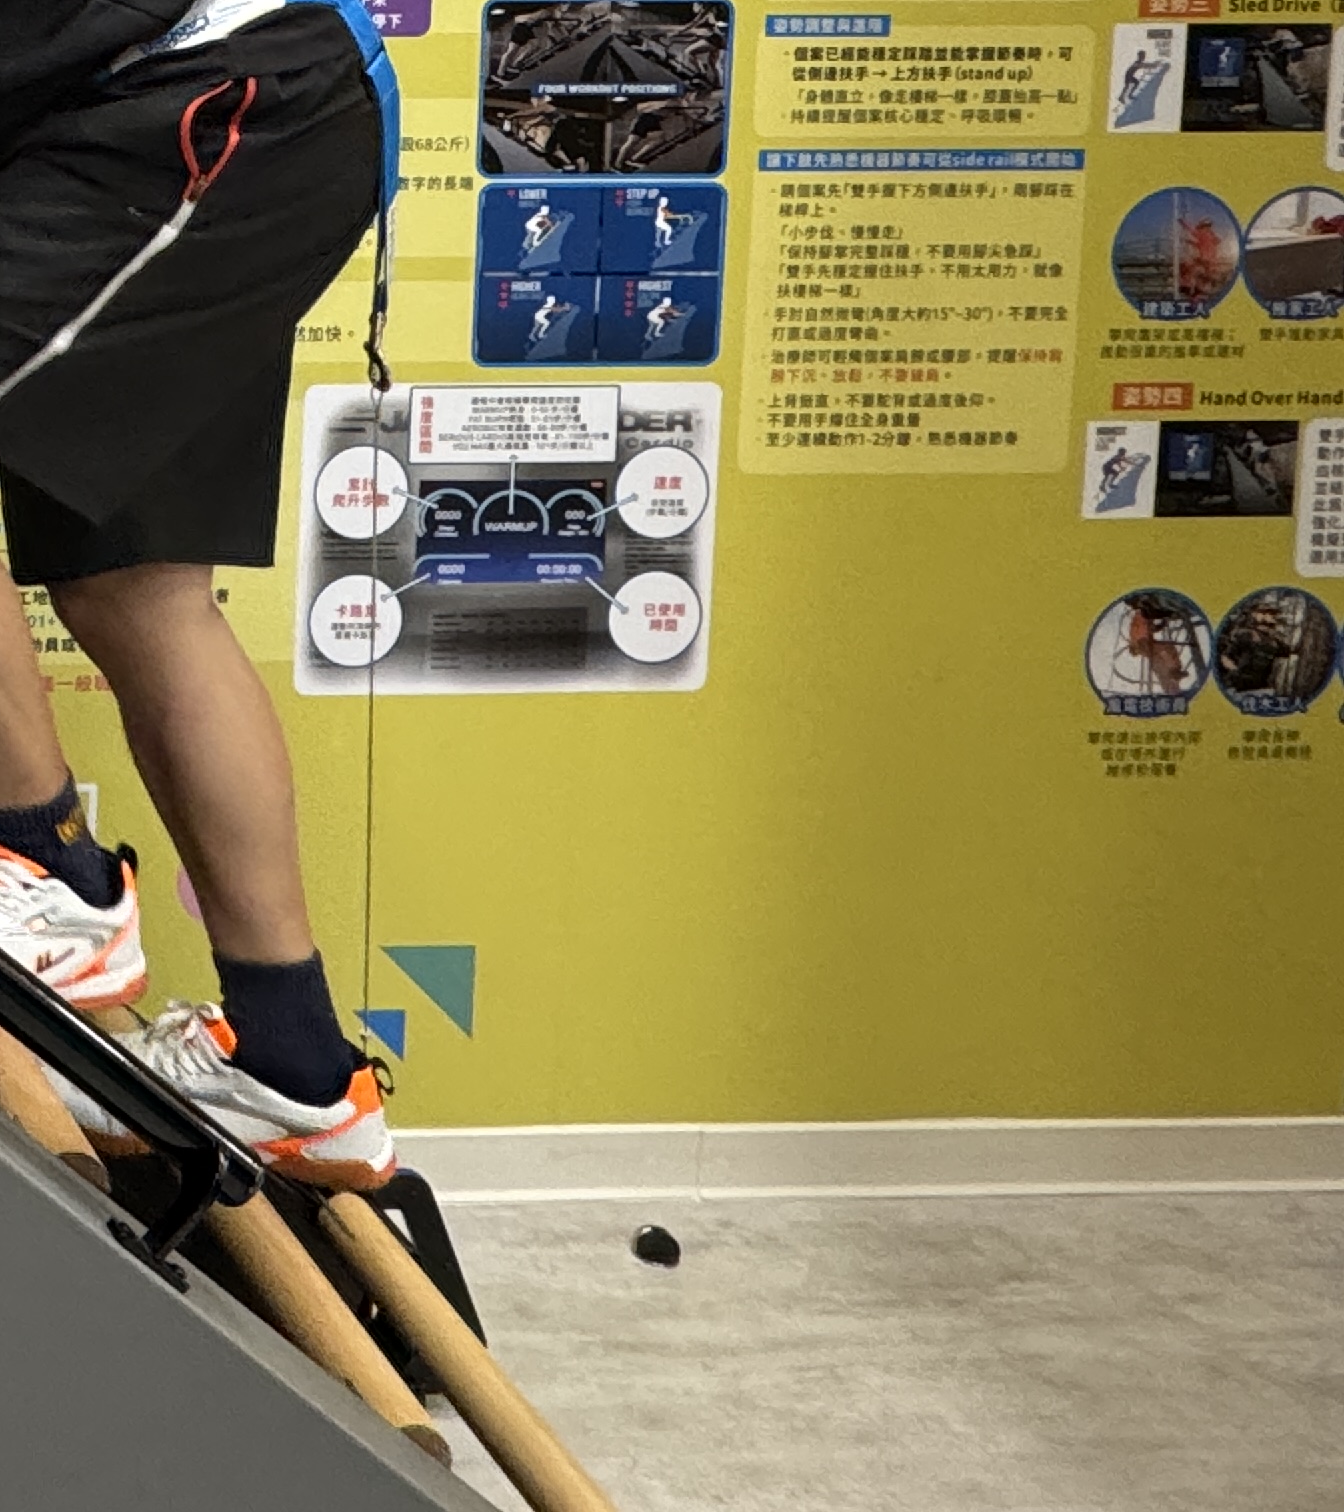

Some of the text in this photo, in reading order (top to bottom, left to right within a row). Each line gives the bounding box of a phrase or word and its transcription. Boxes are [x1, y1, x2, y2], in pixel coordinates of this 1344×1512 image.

[1199, 391, 1247, 407] Hand
[1251, 391, 1293, 407] Over
[1297, 391, 1344, 407] Hand
[484, 521, 539, 532] WARMUP
